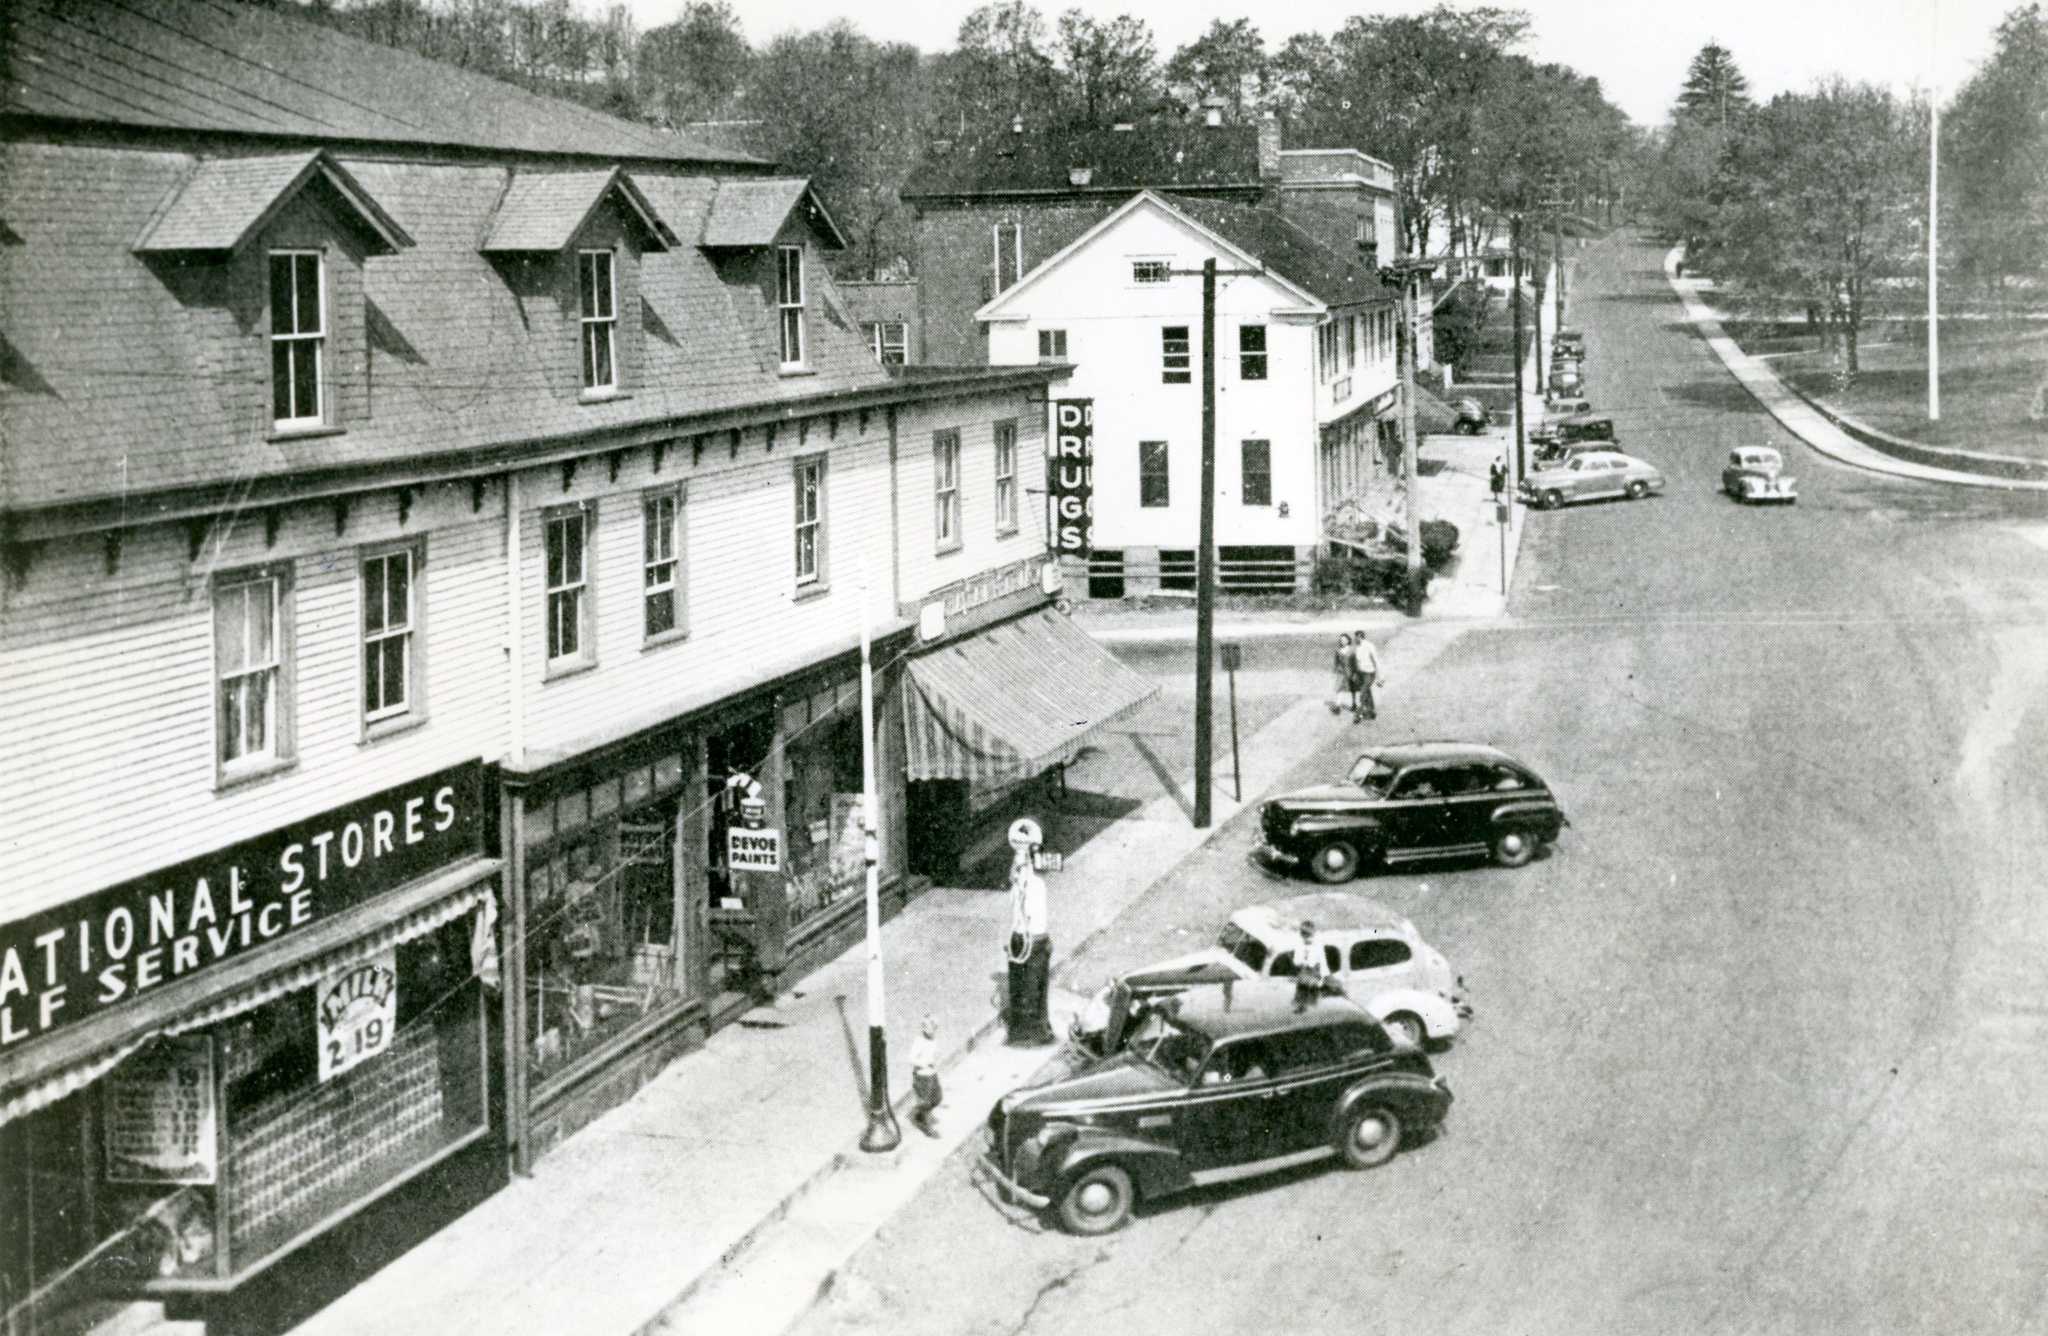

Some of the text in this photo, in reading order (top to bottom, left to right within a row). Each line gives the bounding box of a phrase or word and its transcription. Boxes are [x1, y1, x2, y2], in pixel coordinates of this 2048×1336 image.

[1059, 405, 1083, 549] DRUGS
[731, 835, 777, 852] DEVOE
[731, 852, 777, 865] PAINTS
[0, 786, 455, 1006] ATIONAL STORES
[1, 889, 312, 1044] LF SERVICE
[320, 965, 394, 1035] MILK
[327, 1018, 383, 1069] 2 19
